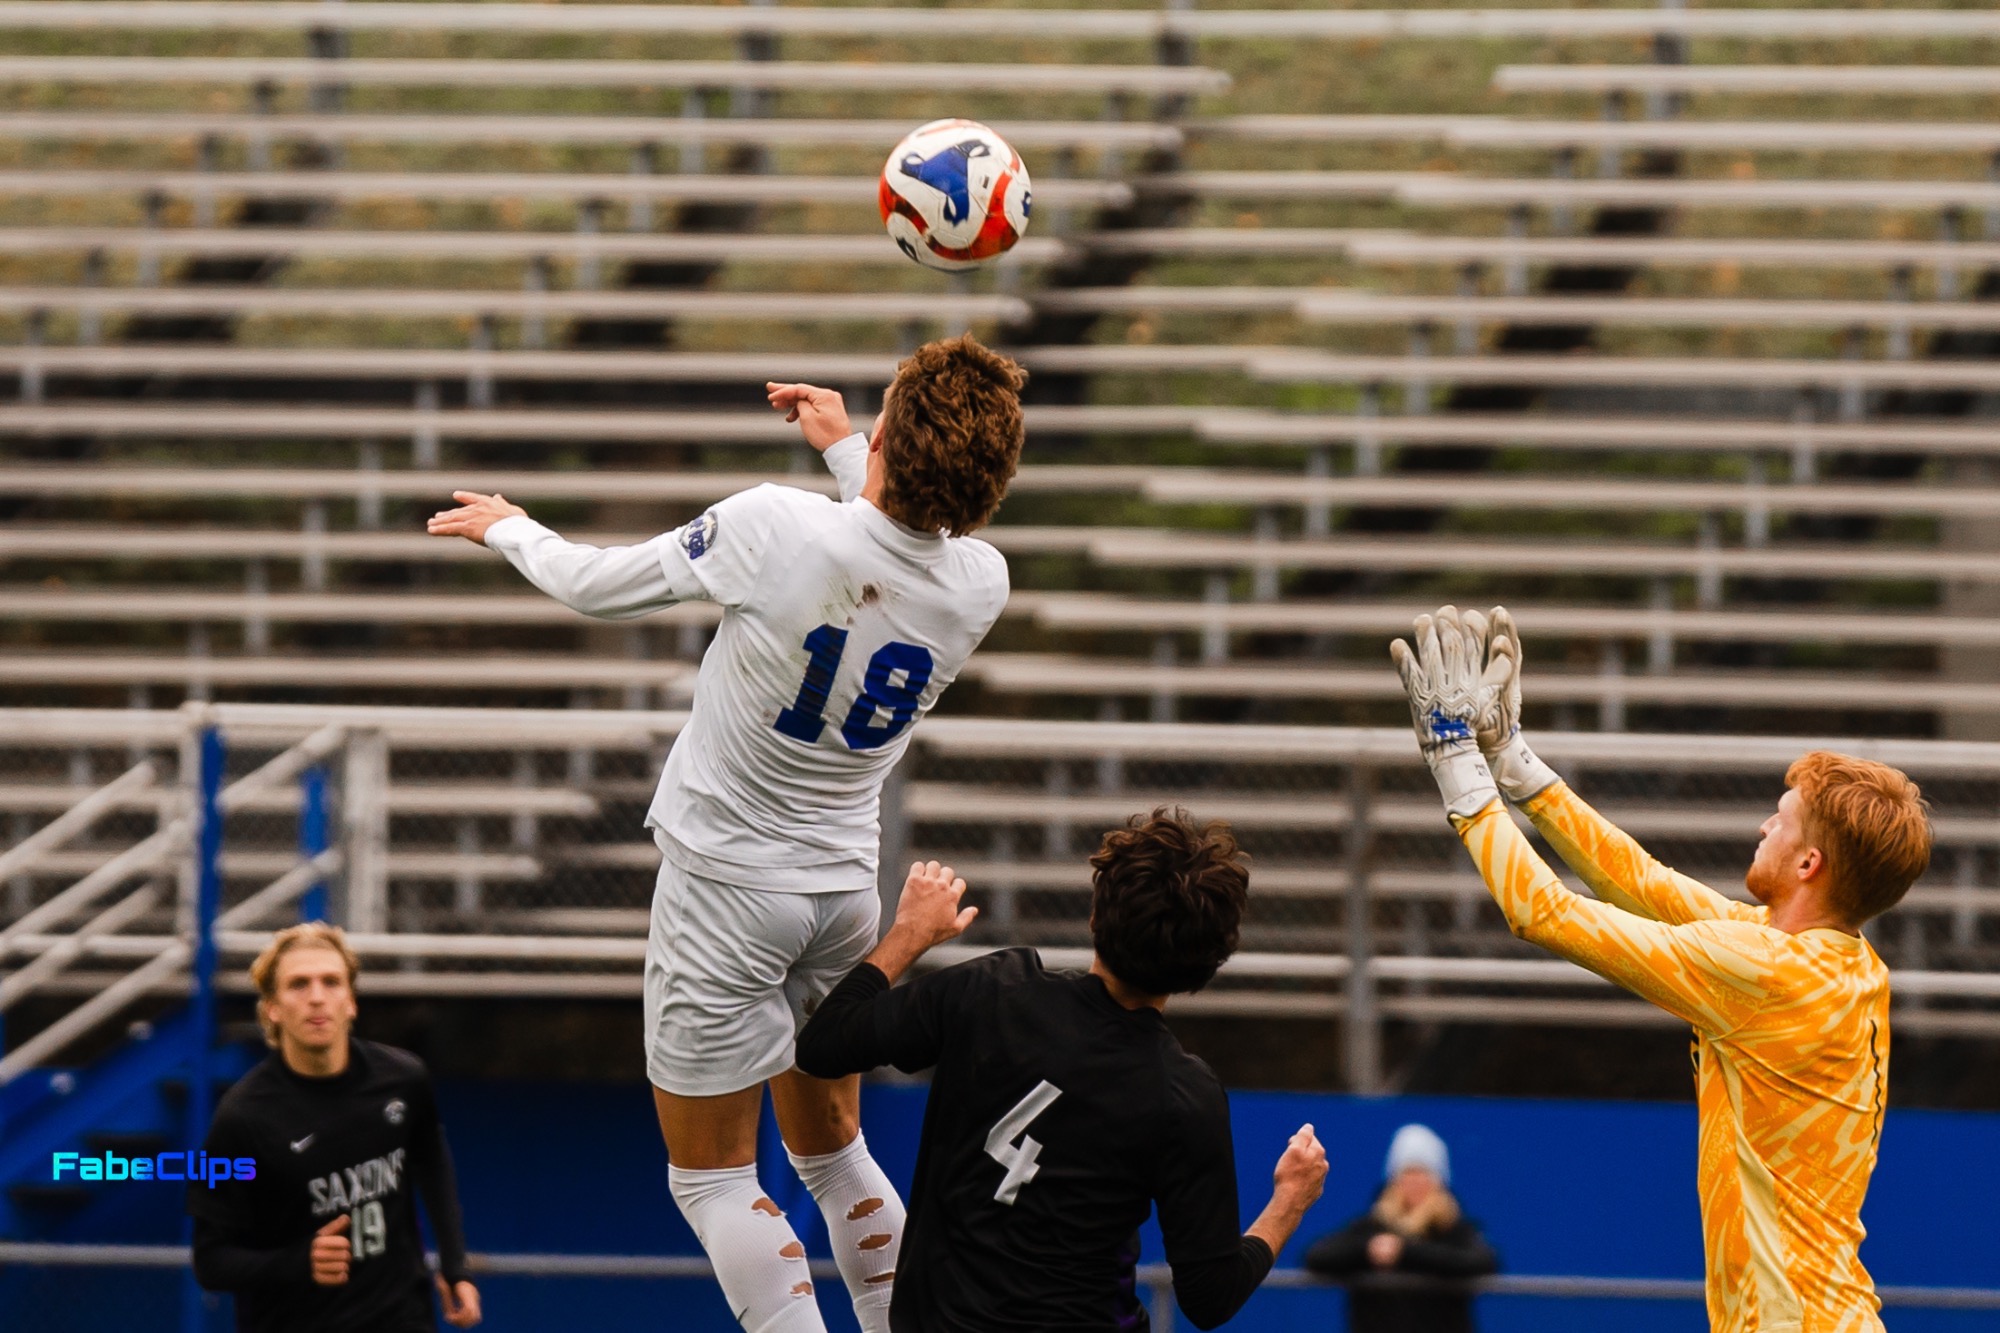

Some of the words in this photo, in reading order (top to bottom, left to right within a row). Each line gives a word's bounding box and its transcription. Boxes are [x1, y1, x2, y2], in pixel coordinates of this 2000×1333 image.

[773, 623, 934, 750] 18
[983, 1079, 1063, 1206] 4
[351, 1200, 386, 1259] 19
